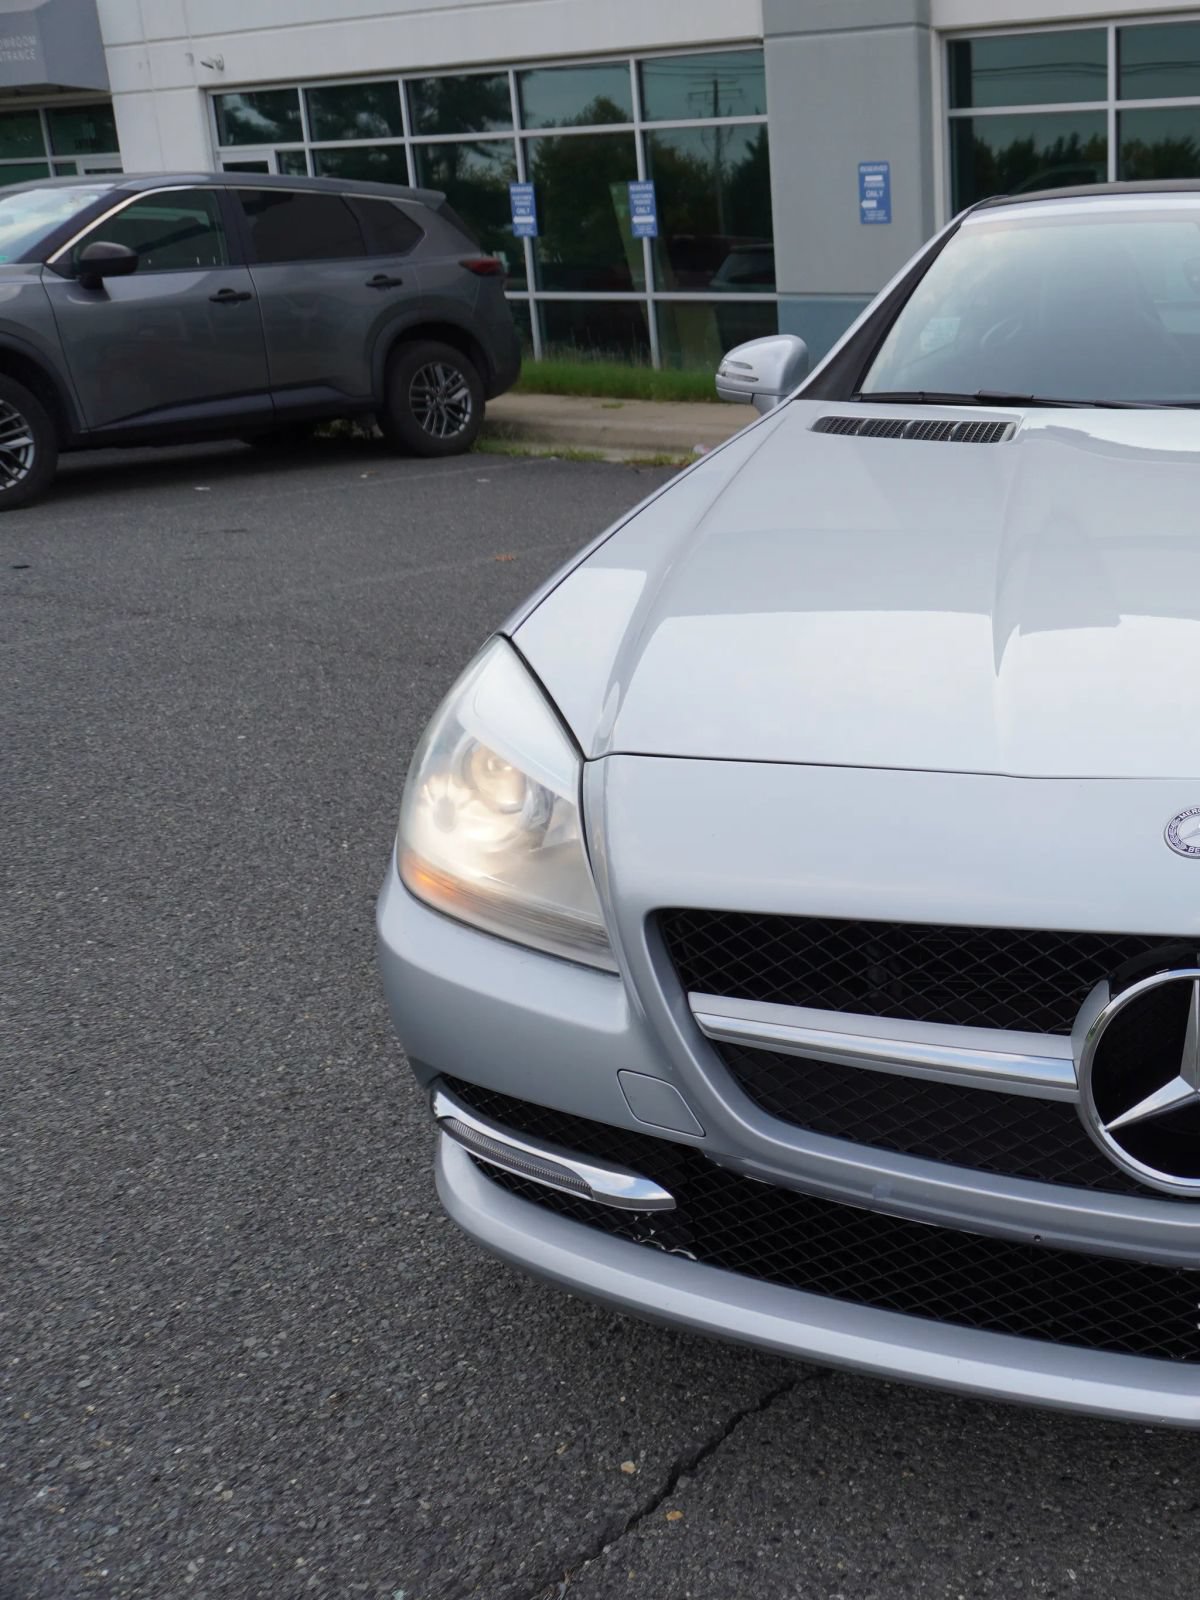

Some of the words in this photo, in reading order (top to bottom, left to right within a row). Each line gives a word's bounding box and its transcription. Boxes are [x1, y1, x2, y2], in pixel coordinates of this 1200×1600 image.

[865, 190, 884, 198] ONLY
[515, 207, 530, 215] ONLY
[635, 206, 650, 214] ONLY
